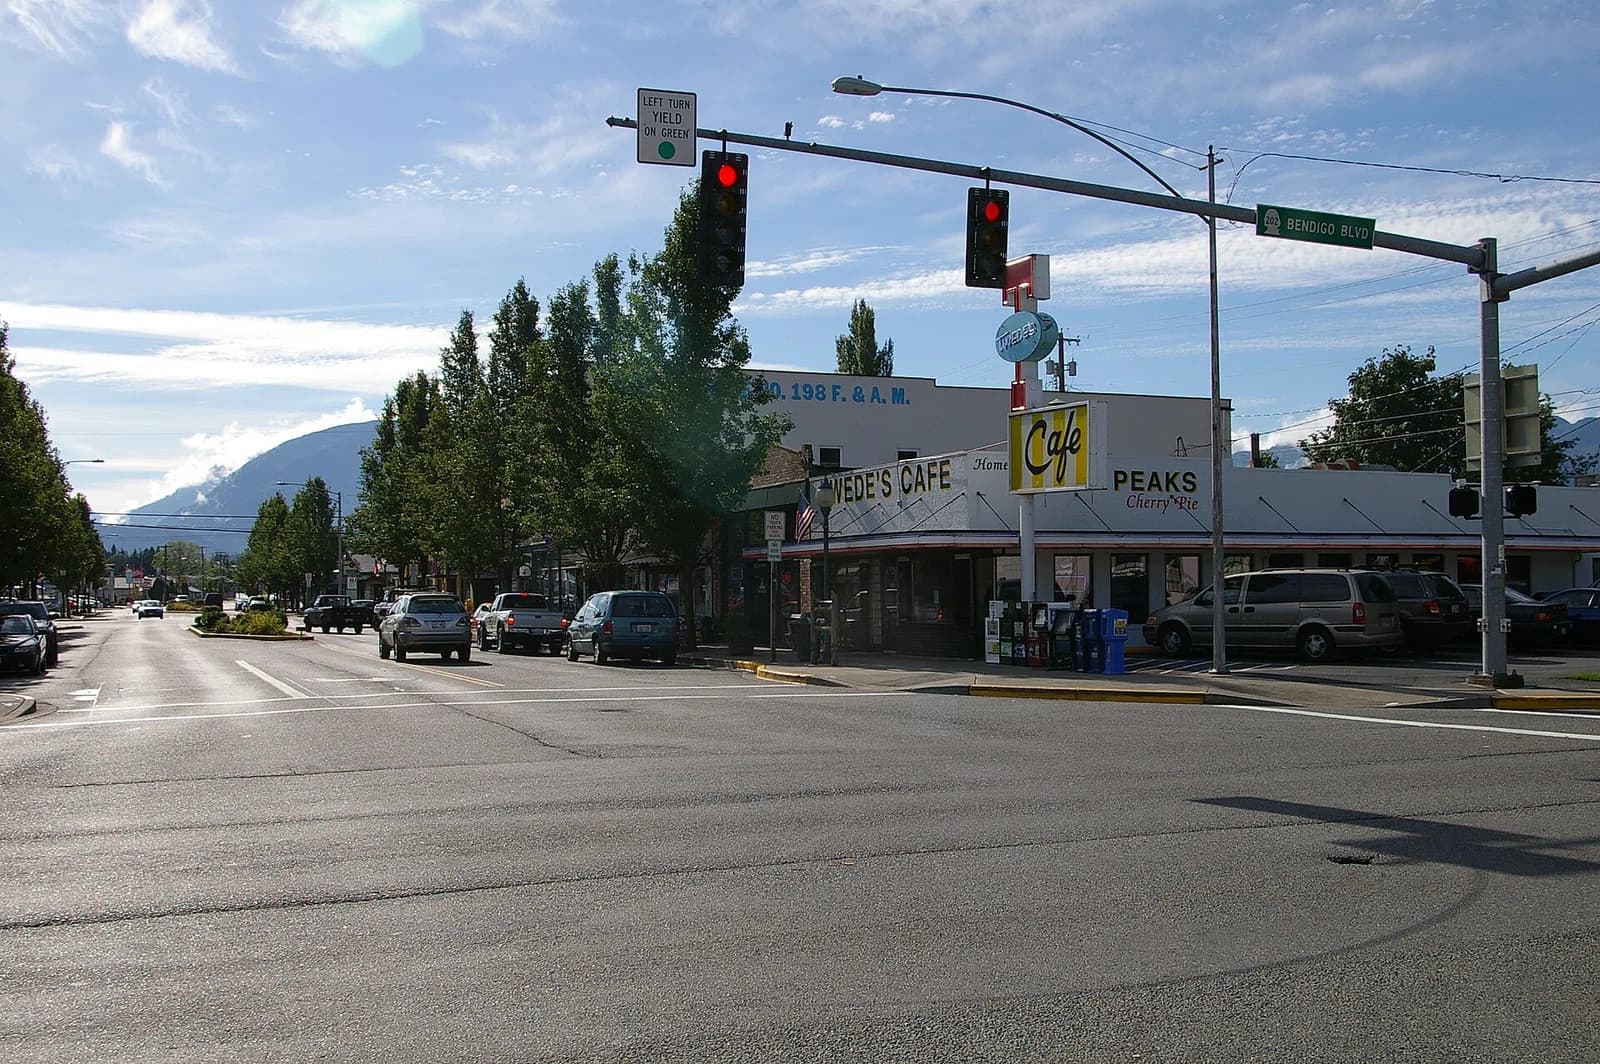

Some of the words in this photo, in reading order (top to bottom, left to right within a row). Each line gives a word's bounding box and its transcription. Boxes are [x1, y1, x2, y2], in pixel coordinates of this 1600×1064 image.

[643, 96, 663, 107] LEFT
[668, 98, 690, 109] TURN
[653, 111, 682, 125] YIELD
[644, 126, 656, 137] ON
[661, 127, 689, 139] GREEN
[1265, 215, 1279, 225] 202
[1287, 217, 1335, 235] BENDIGO
[1341, 225, 1369, 240] BLVD
[791, 382, 826, 401] 198
[831, 384, 847, 402] F.
[852, 385, 865, 403] &
[870, 386, 887, 404] A.
[891, 387, 911, 405] M.
[1025, 410, 1081, 484] Cafe
[972, 456, 1008, 471] Home
[829, 469, 892, 504] WEDE'S
[901, 459, 951, 495] CAFE
[1113, 470, 1197, 493] PEAKS
[1126, 494, 1170, 514] Cherry
[1176, 496, 1198, 510] Pie
